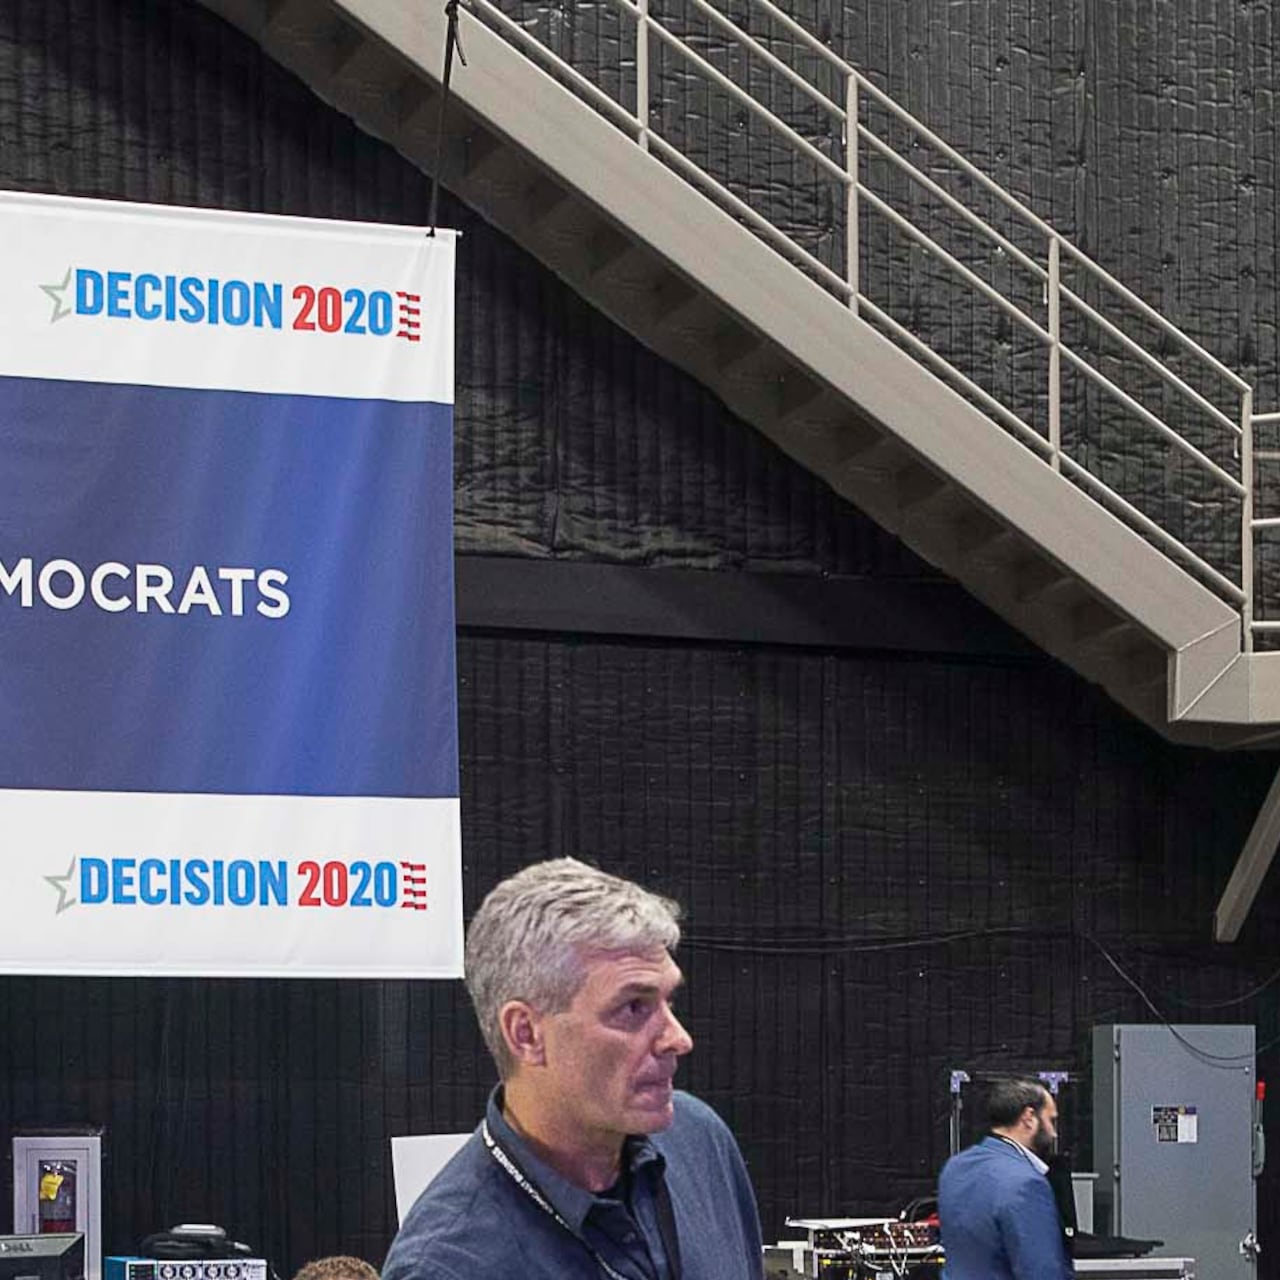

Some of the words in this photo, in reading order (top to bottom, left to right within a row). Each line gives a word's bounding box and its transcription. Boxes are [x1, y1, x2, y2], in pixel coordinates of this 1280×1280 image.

[76, 269, 283, 330] DECISION
[293, 286, 393, 337] 2020
[80, 857, 289, 907] DECISION
[298, 861, 398, 909] 2020
[491, 1145, 524, 1183] BUSINESS
